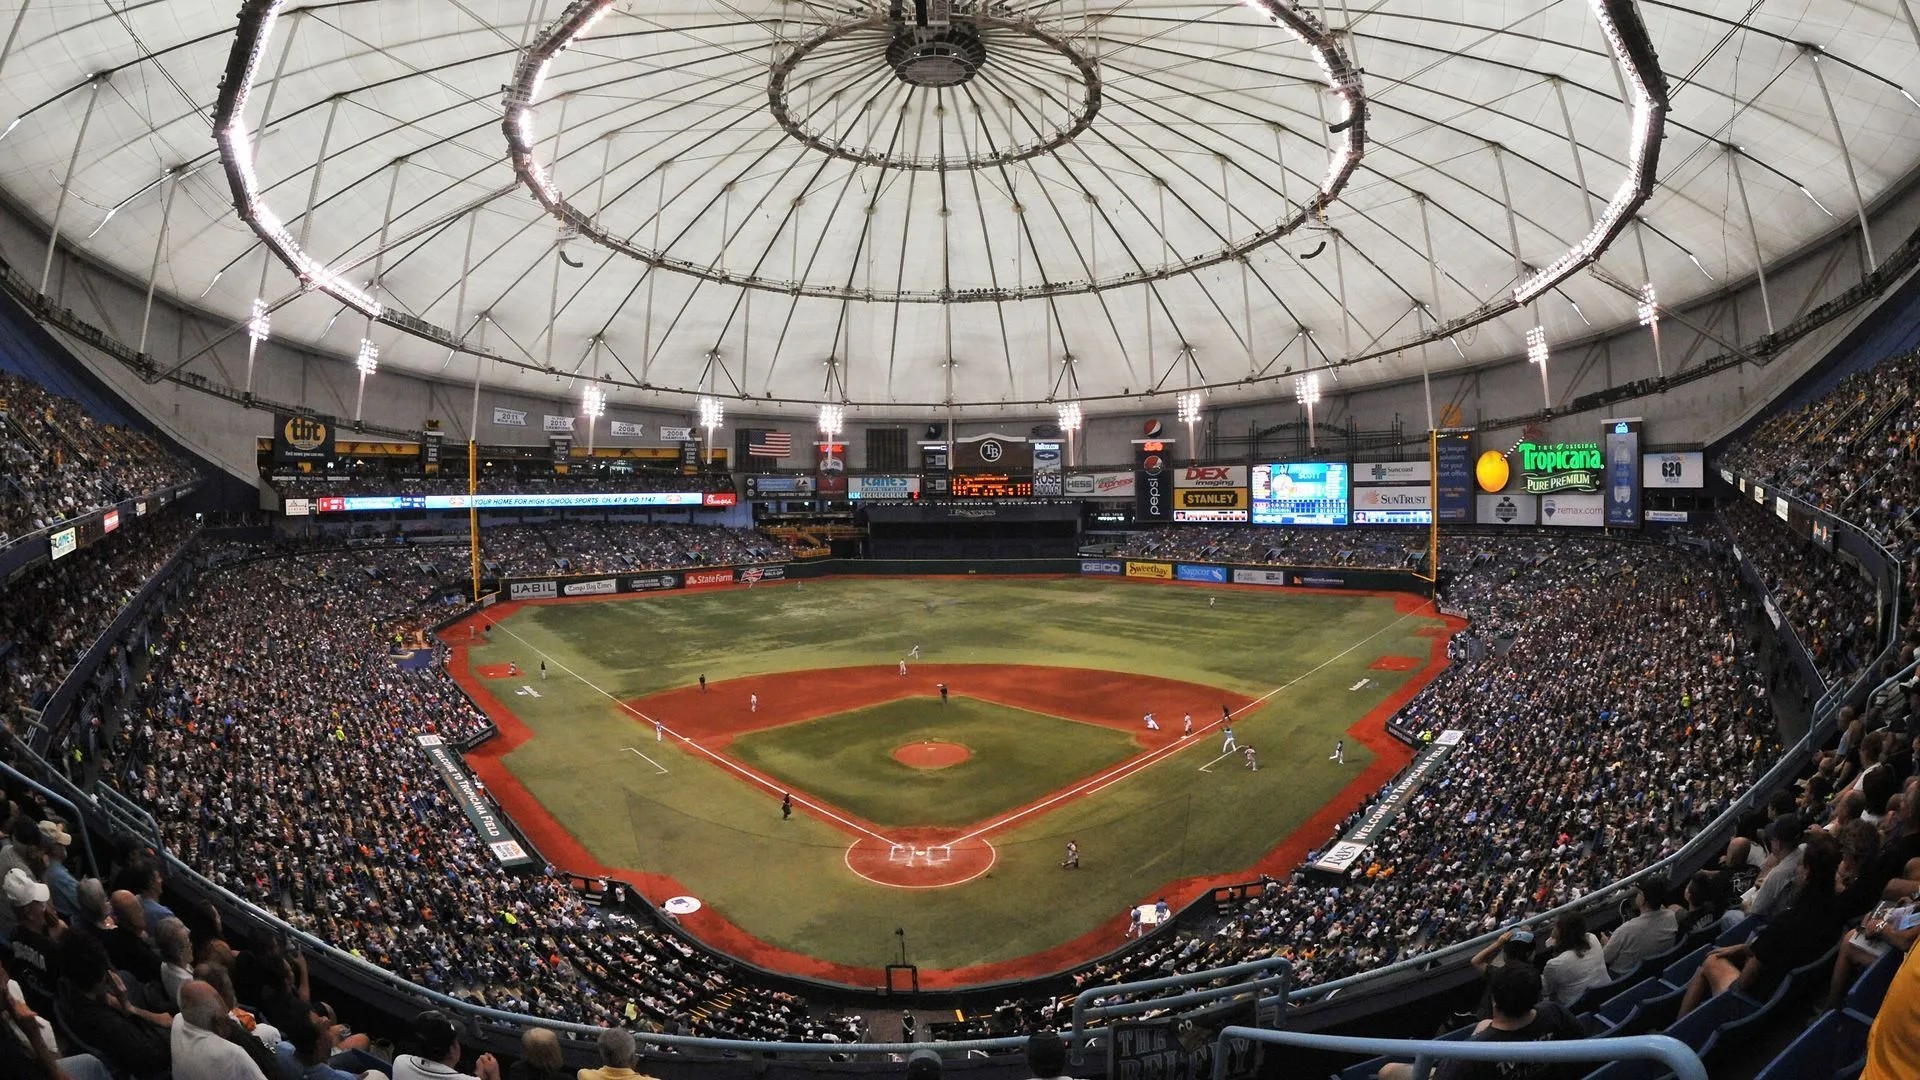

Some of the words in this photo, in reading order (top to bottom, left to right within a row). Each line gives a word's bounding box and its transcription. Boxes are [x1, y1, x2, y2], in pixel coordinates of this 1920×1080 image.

[290, 417, 320, 441] tbt
[984, 444, 999, 459] TB
[1518, 443, 1601, 473] Tropicana
[1186, 468, 1230, 480] DEX
[1662, 462, 1682, 477] 620
[1034, 475, 1060, 484] ROSE
[1527, 480, 1550, 490] PURE
[1550, 475, 1590, 488] PREMIUM
[1148, 478, 1160, 515] pepsi
[1187, 494, 1234, 503] STANLEY
[1558, 507, 1603, 515] remax.com
[1082, 562, 1120, 572] GEICO
[1130, 562, 1168, 577] Sweetbay
[1181, 566, 1209, 578] Sagicor
[512, 583, 556, 594] JABIL
[431, 748, 457, 774] WELCOME
[452, 773, 463, 781] TO
[459, 780, 486, 816] TROPICANA
[480, 814, 500, 836] FIELD
[1352, 804, 1392, 840] WELCOME
[1387, 794, 1399, 806] TO
[1394, 761, 1431, 795] TROPICANA
[1426, 746, 1447, 764] FIELD
[1117, 1029, 1167, 1057] THE
